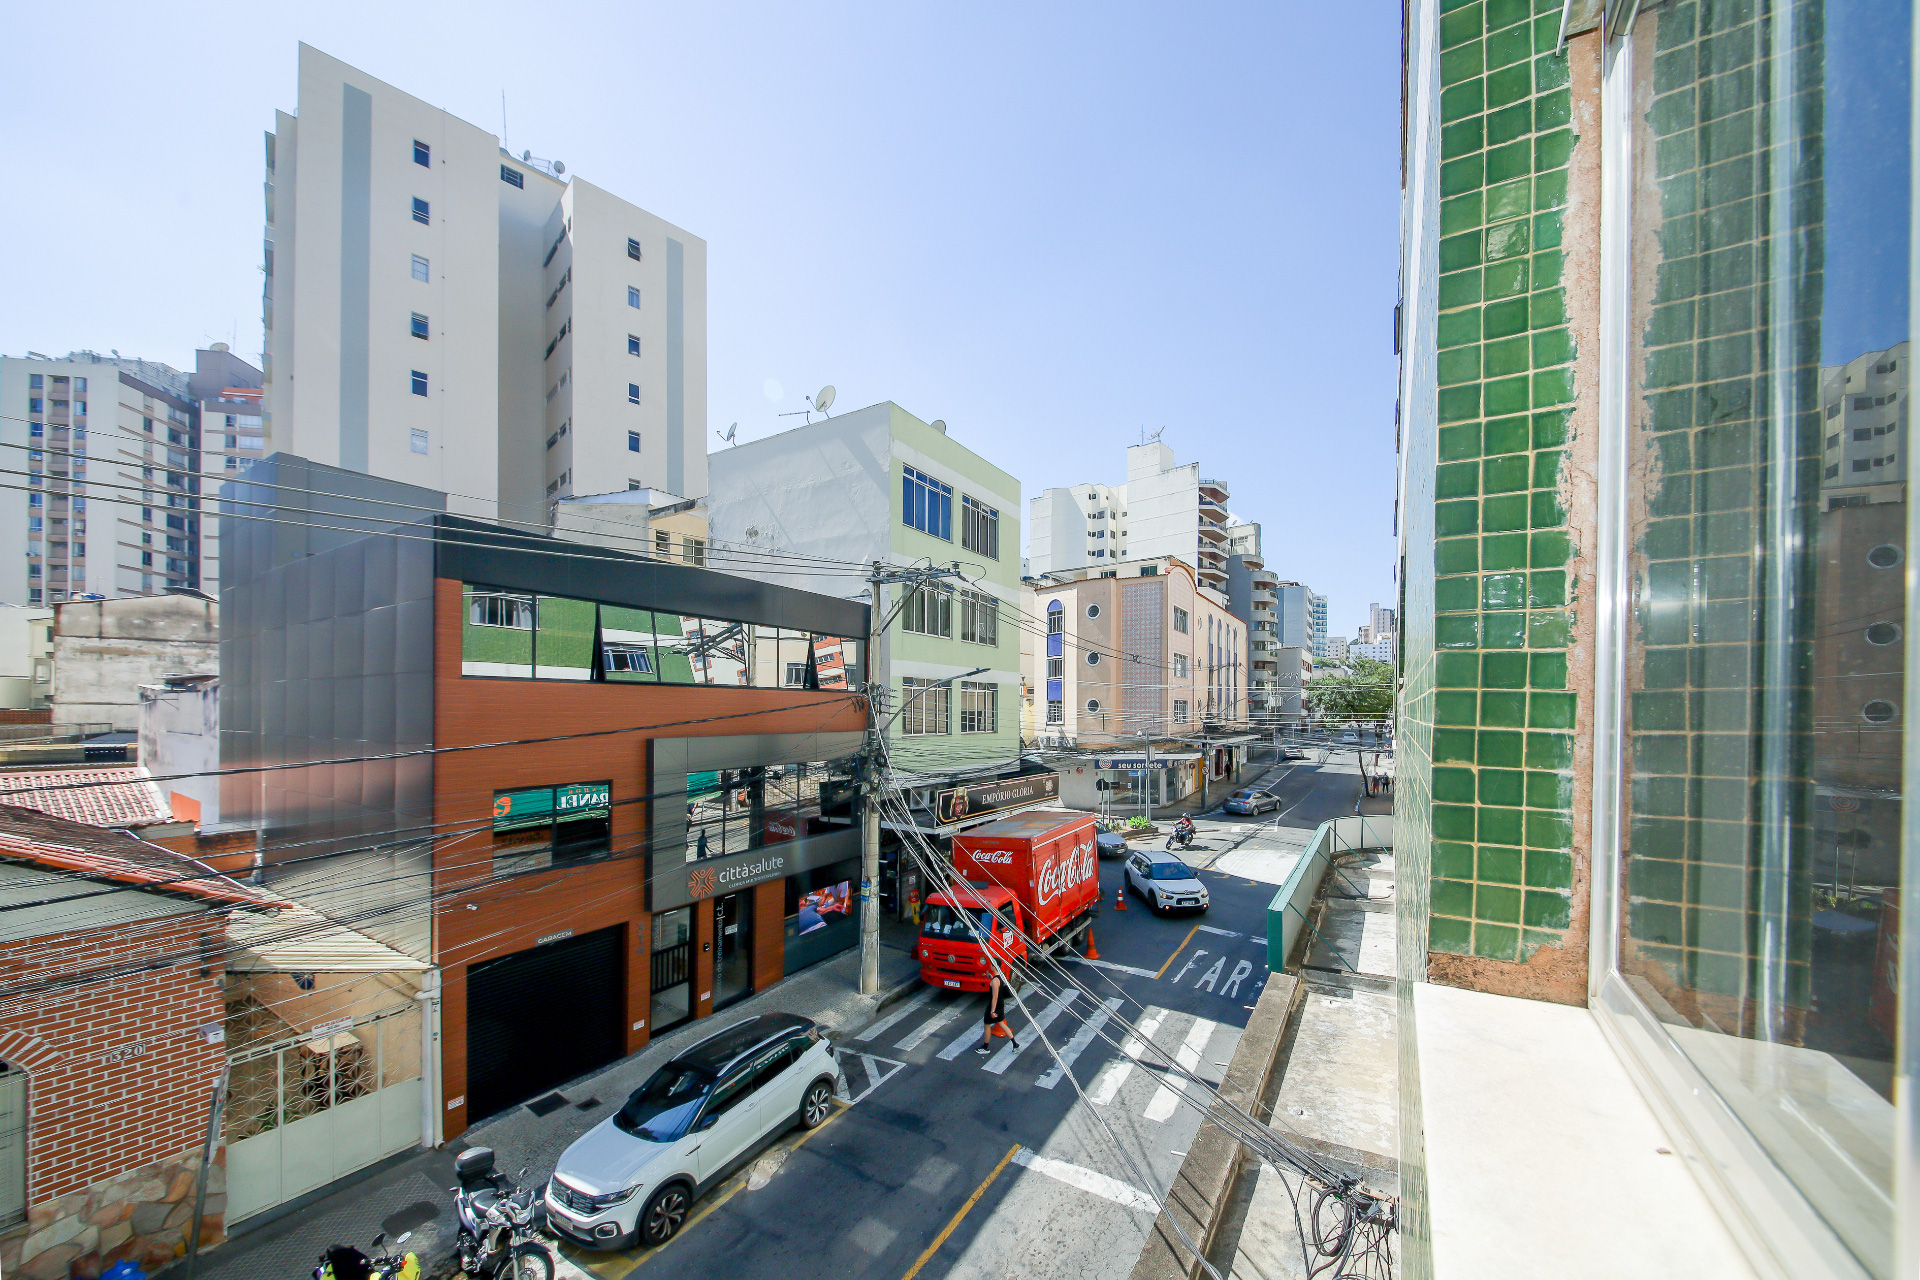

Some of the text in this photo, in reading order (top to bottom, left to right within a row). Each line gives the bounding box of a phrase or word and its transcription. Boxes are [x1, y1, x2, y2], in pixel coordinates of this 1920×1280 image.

[982, 785, 1034, 805] EMPÓRIO GLÓRIA
[972, 849, 1013, 864] Coca-Cola
[719, 856, 784, 883] cittàsalute
[1037, 839, 1094, 906] Coca-Cola
[537, 930, 572, 944] GARAGEM
[112, 1044, 144, 1062] 320
